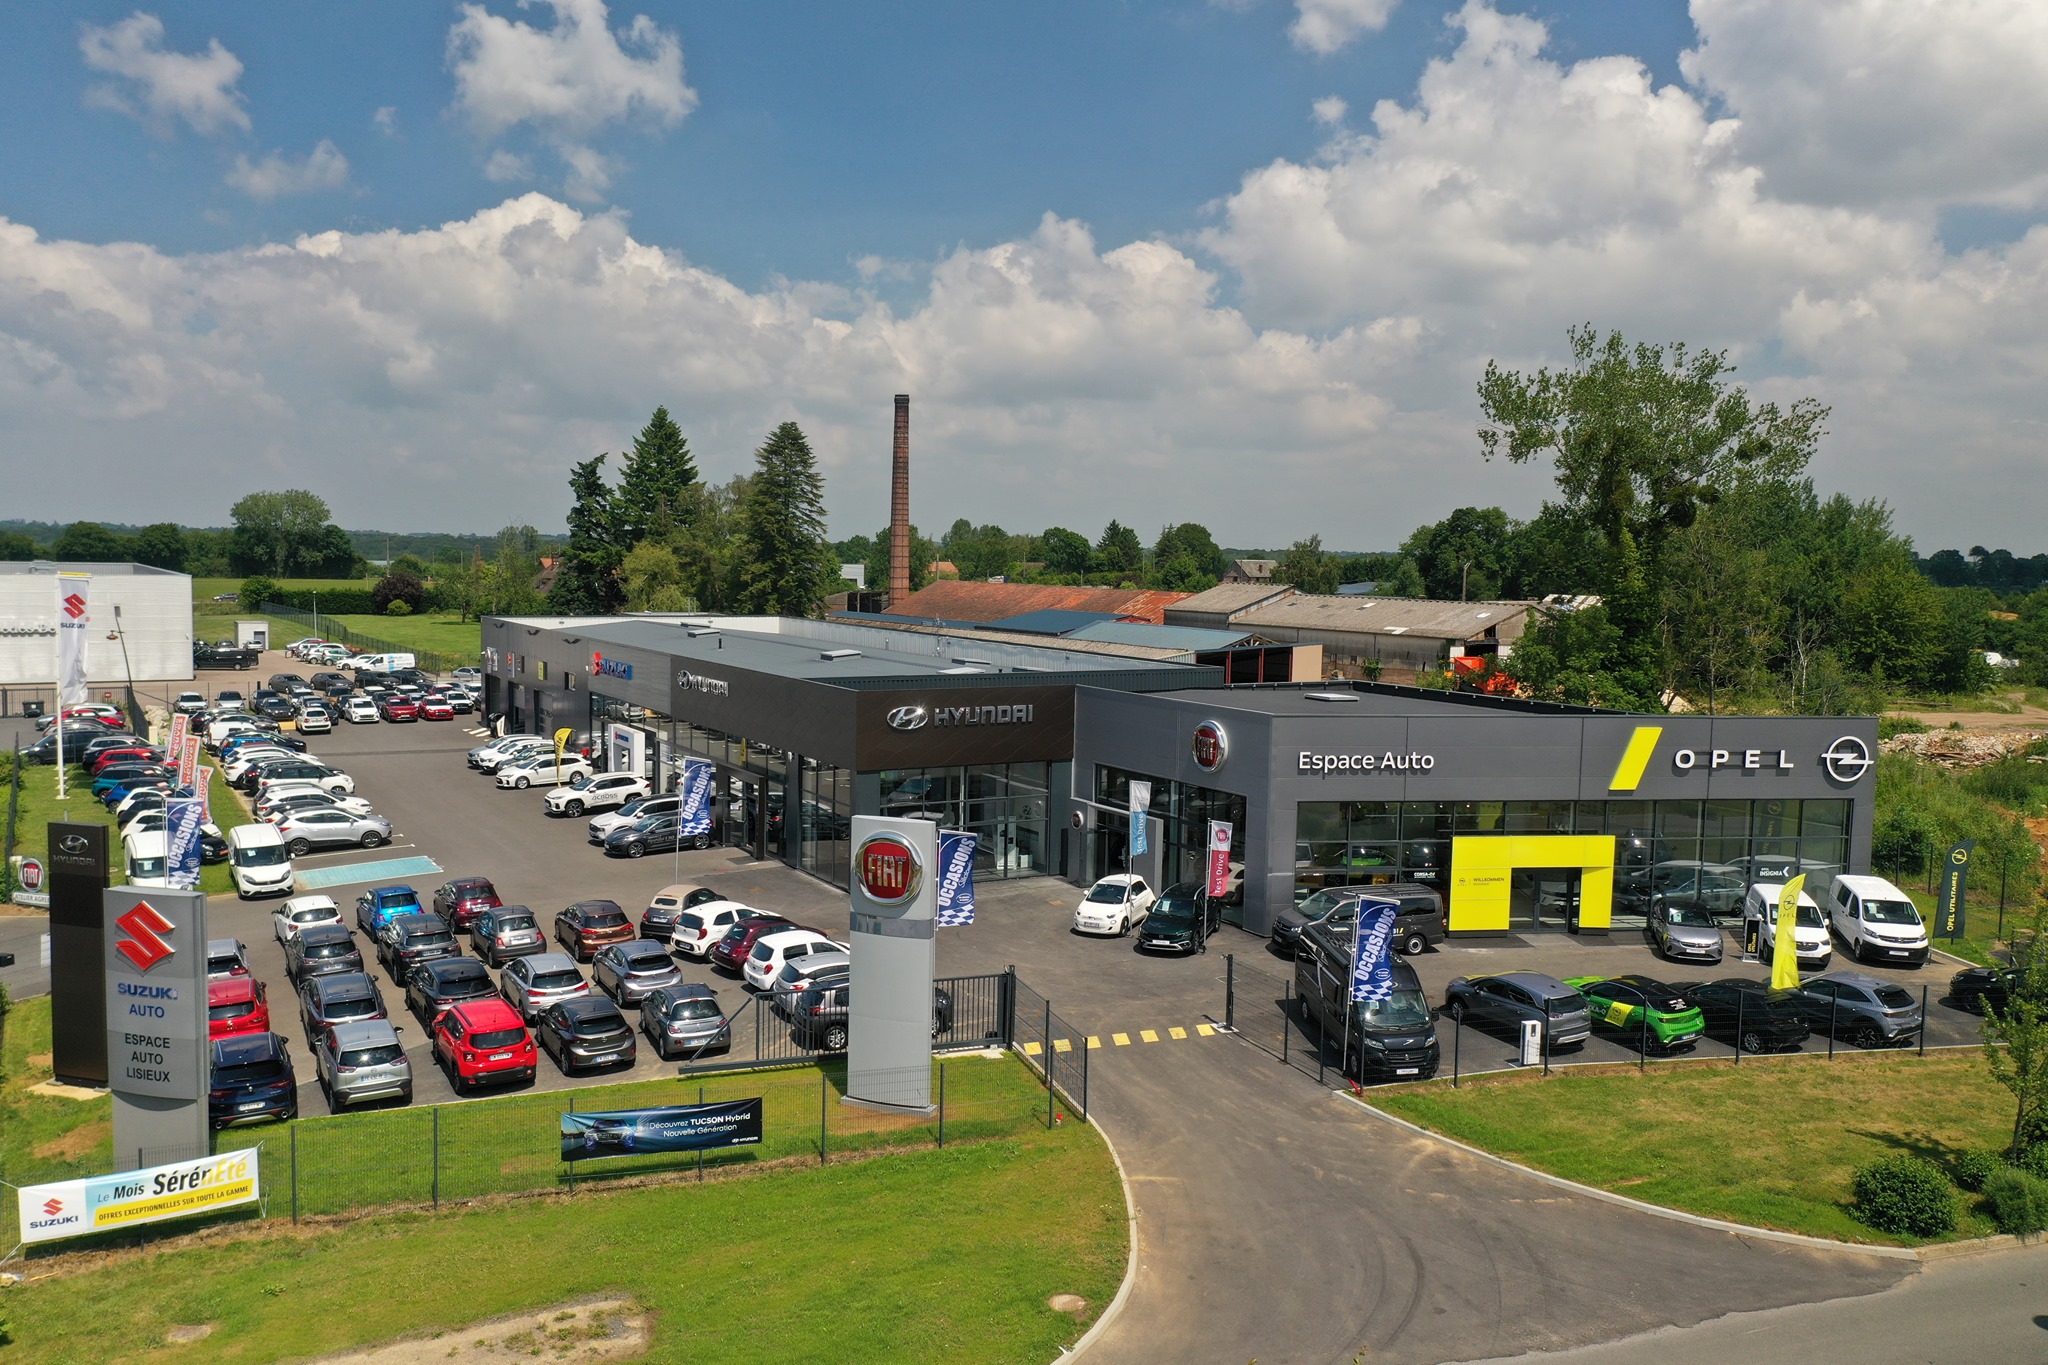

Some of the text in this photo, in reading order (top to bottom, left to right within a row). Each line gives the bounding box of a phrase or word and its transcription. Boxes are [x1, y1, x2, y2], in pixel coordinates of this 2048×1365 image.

[934, 704, 1034, 727] HYUNDAI
[1298, 751, 1435, 773] Espace Auto
[1674, 749, 1794, 769] OPEL
[592, 793, 618, 801] ACROSS
[682, 765, 711, 821] OCCASIONS
[168, 803, 202, 869] OCCASIONS
[53, 854, 96, 866] HYUNDAI
[24, 868, 38, 884] FIAT
[867, 853, 907, 888] FIAT
[938, 837, 976, 907] OCCASIONS
[1215, 854, 1224, 894] Test Drive
[15, 892, 34, 901] ATELIER
[1947, 871, 1959, 931] OPEL UTILITAIRES
[1355, 908, 1396, 981] OCCASIONS
[129, 1004, 165, 1018] AUTO
[125, 1033, 171, 1049] ESPACE
[131, 1051, 164, 1065] AUTO
[126, 1067, 171, 1082] LISIEUX
[649, 1112, 751, 1130] Découvrez TUCSON Hybrid
[663, 1123, 738, 1138] Nouvelle Génération
[97, 1193, 109, 1203] Le
[113, 1182, 145, 1200] Mois
[98, 1185, 249, 1221] OFFRES EXCEPTIONNELLES SUR TOUTE LA GAMME
[29, 1215, 79, 1229] SUZUKI
